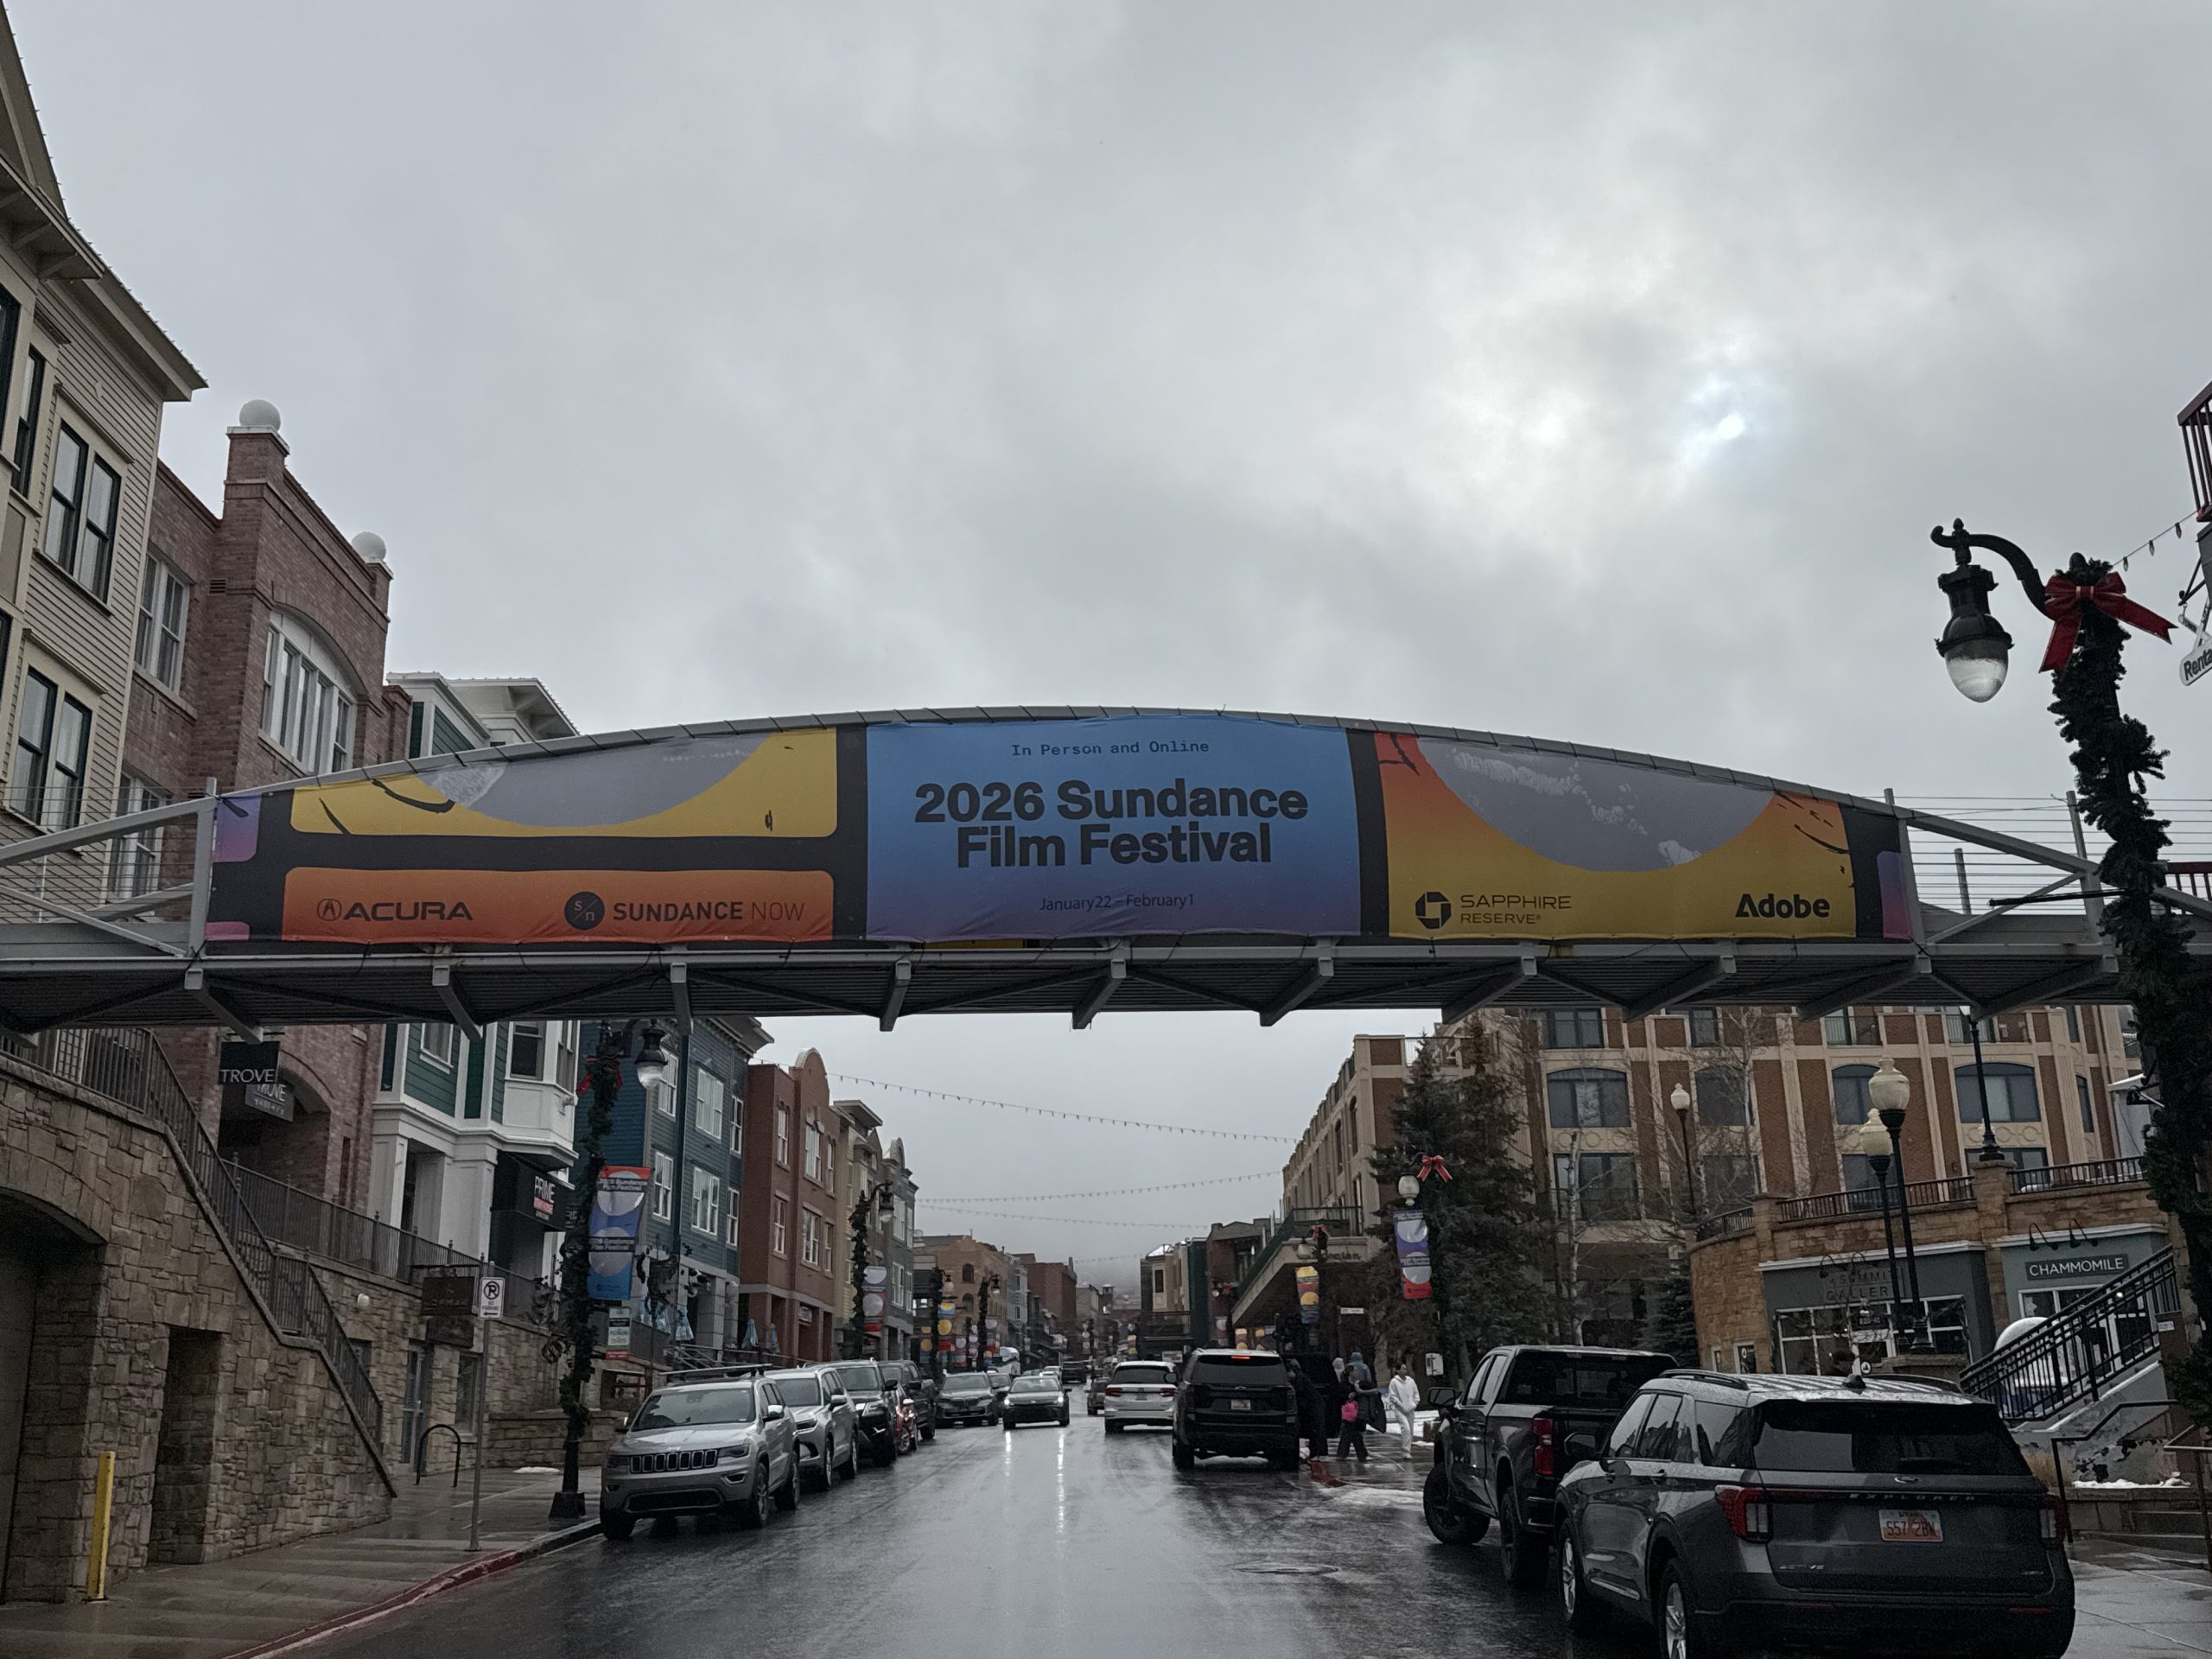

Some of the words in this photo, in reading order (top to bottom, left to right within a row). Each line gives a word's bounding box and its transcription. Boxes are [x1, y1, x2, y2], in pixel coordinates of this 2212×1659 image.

[1012, 744, 1032, 756] In
[1040, 743, 1102, 755] Person
[1110, 741, 1140, 753] and
[1149, 740, 1209, 753] Online
[915, 781, 1045, 823] 2026
[1057, 778, 1308, 820] Sundance
[957, 823, 1065, 868] Film
[1080, 821, 1271, 865] Festival
[343, 901, 474, 922] ACURA
[613, 901, 743, 922] SUNDANCE
[751, 901, 805, 922] NOW
[1039, 895, 1111, 912] January22
[1460, 894, 1573, 910] SAPPHIRE
[1735, 893, 1830, 918] Adobe
[219, 1068, 275, 1084] TROVE
[2029, 1257, 2125, 1277] CHAMMOMILE
